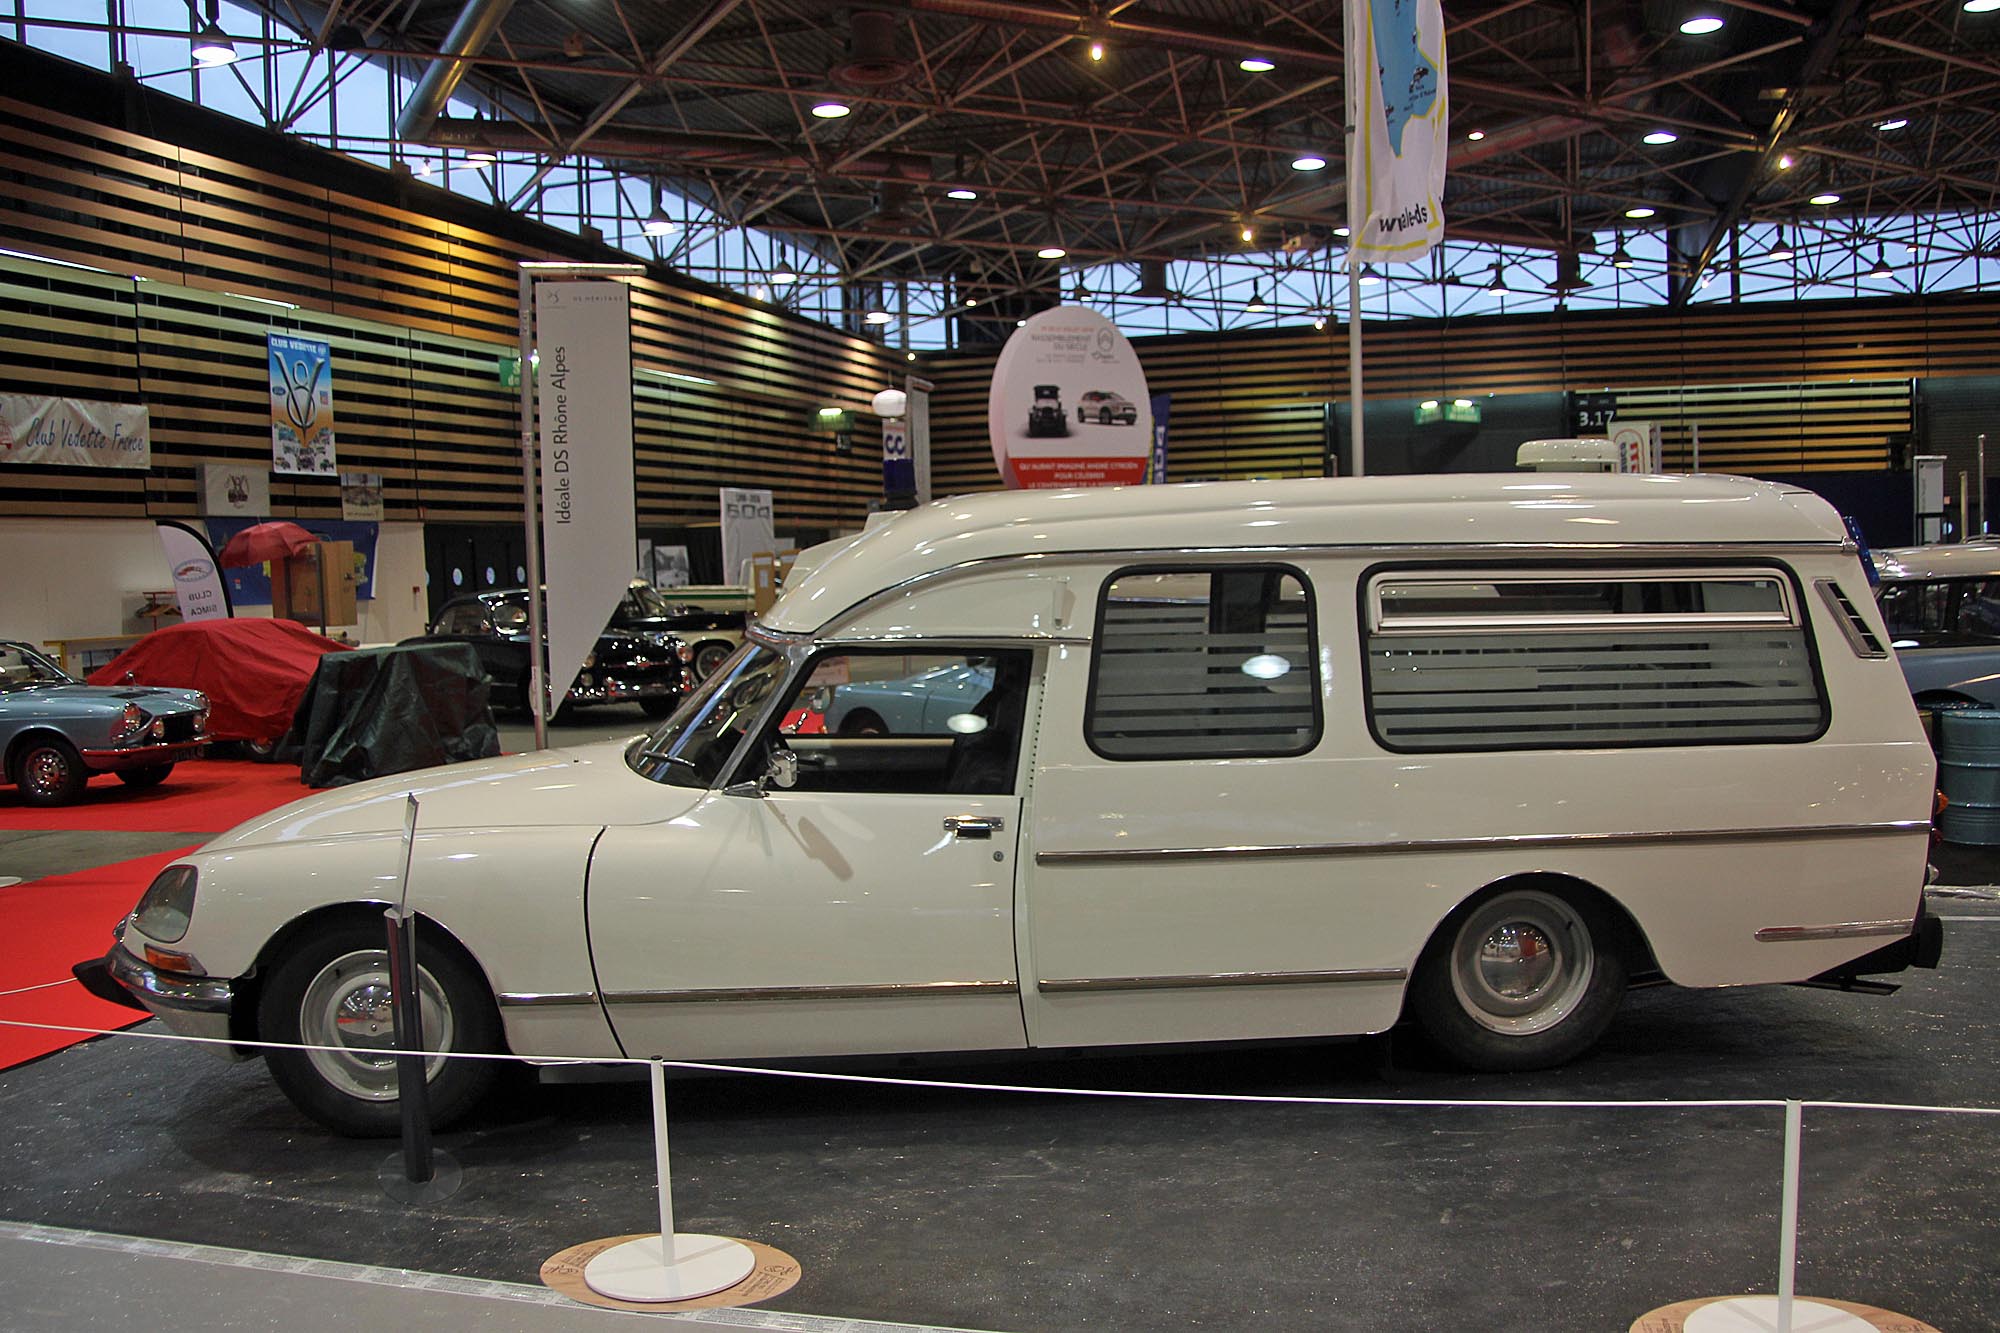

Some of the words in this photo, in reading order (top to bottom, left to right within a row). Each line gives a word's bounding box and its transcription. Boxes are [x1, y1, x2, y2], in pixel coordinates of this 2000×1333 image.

[271, 337, 288, 348] CLUB
[289, 340, 317, 354] VEDETTE
[550, 346, 570, 390] Alpes
[26, 417, 55, 447] Club
[60, 418, 106, 449] Vedette
[111, 423, 144, 453] France
[552, 394, 568, 445] Rhône
[1579, 410, 1614, 426] 3.17
[553, 449, 569, 473] DS
[554, 478, 571, 524] Idéale
